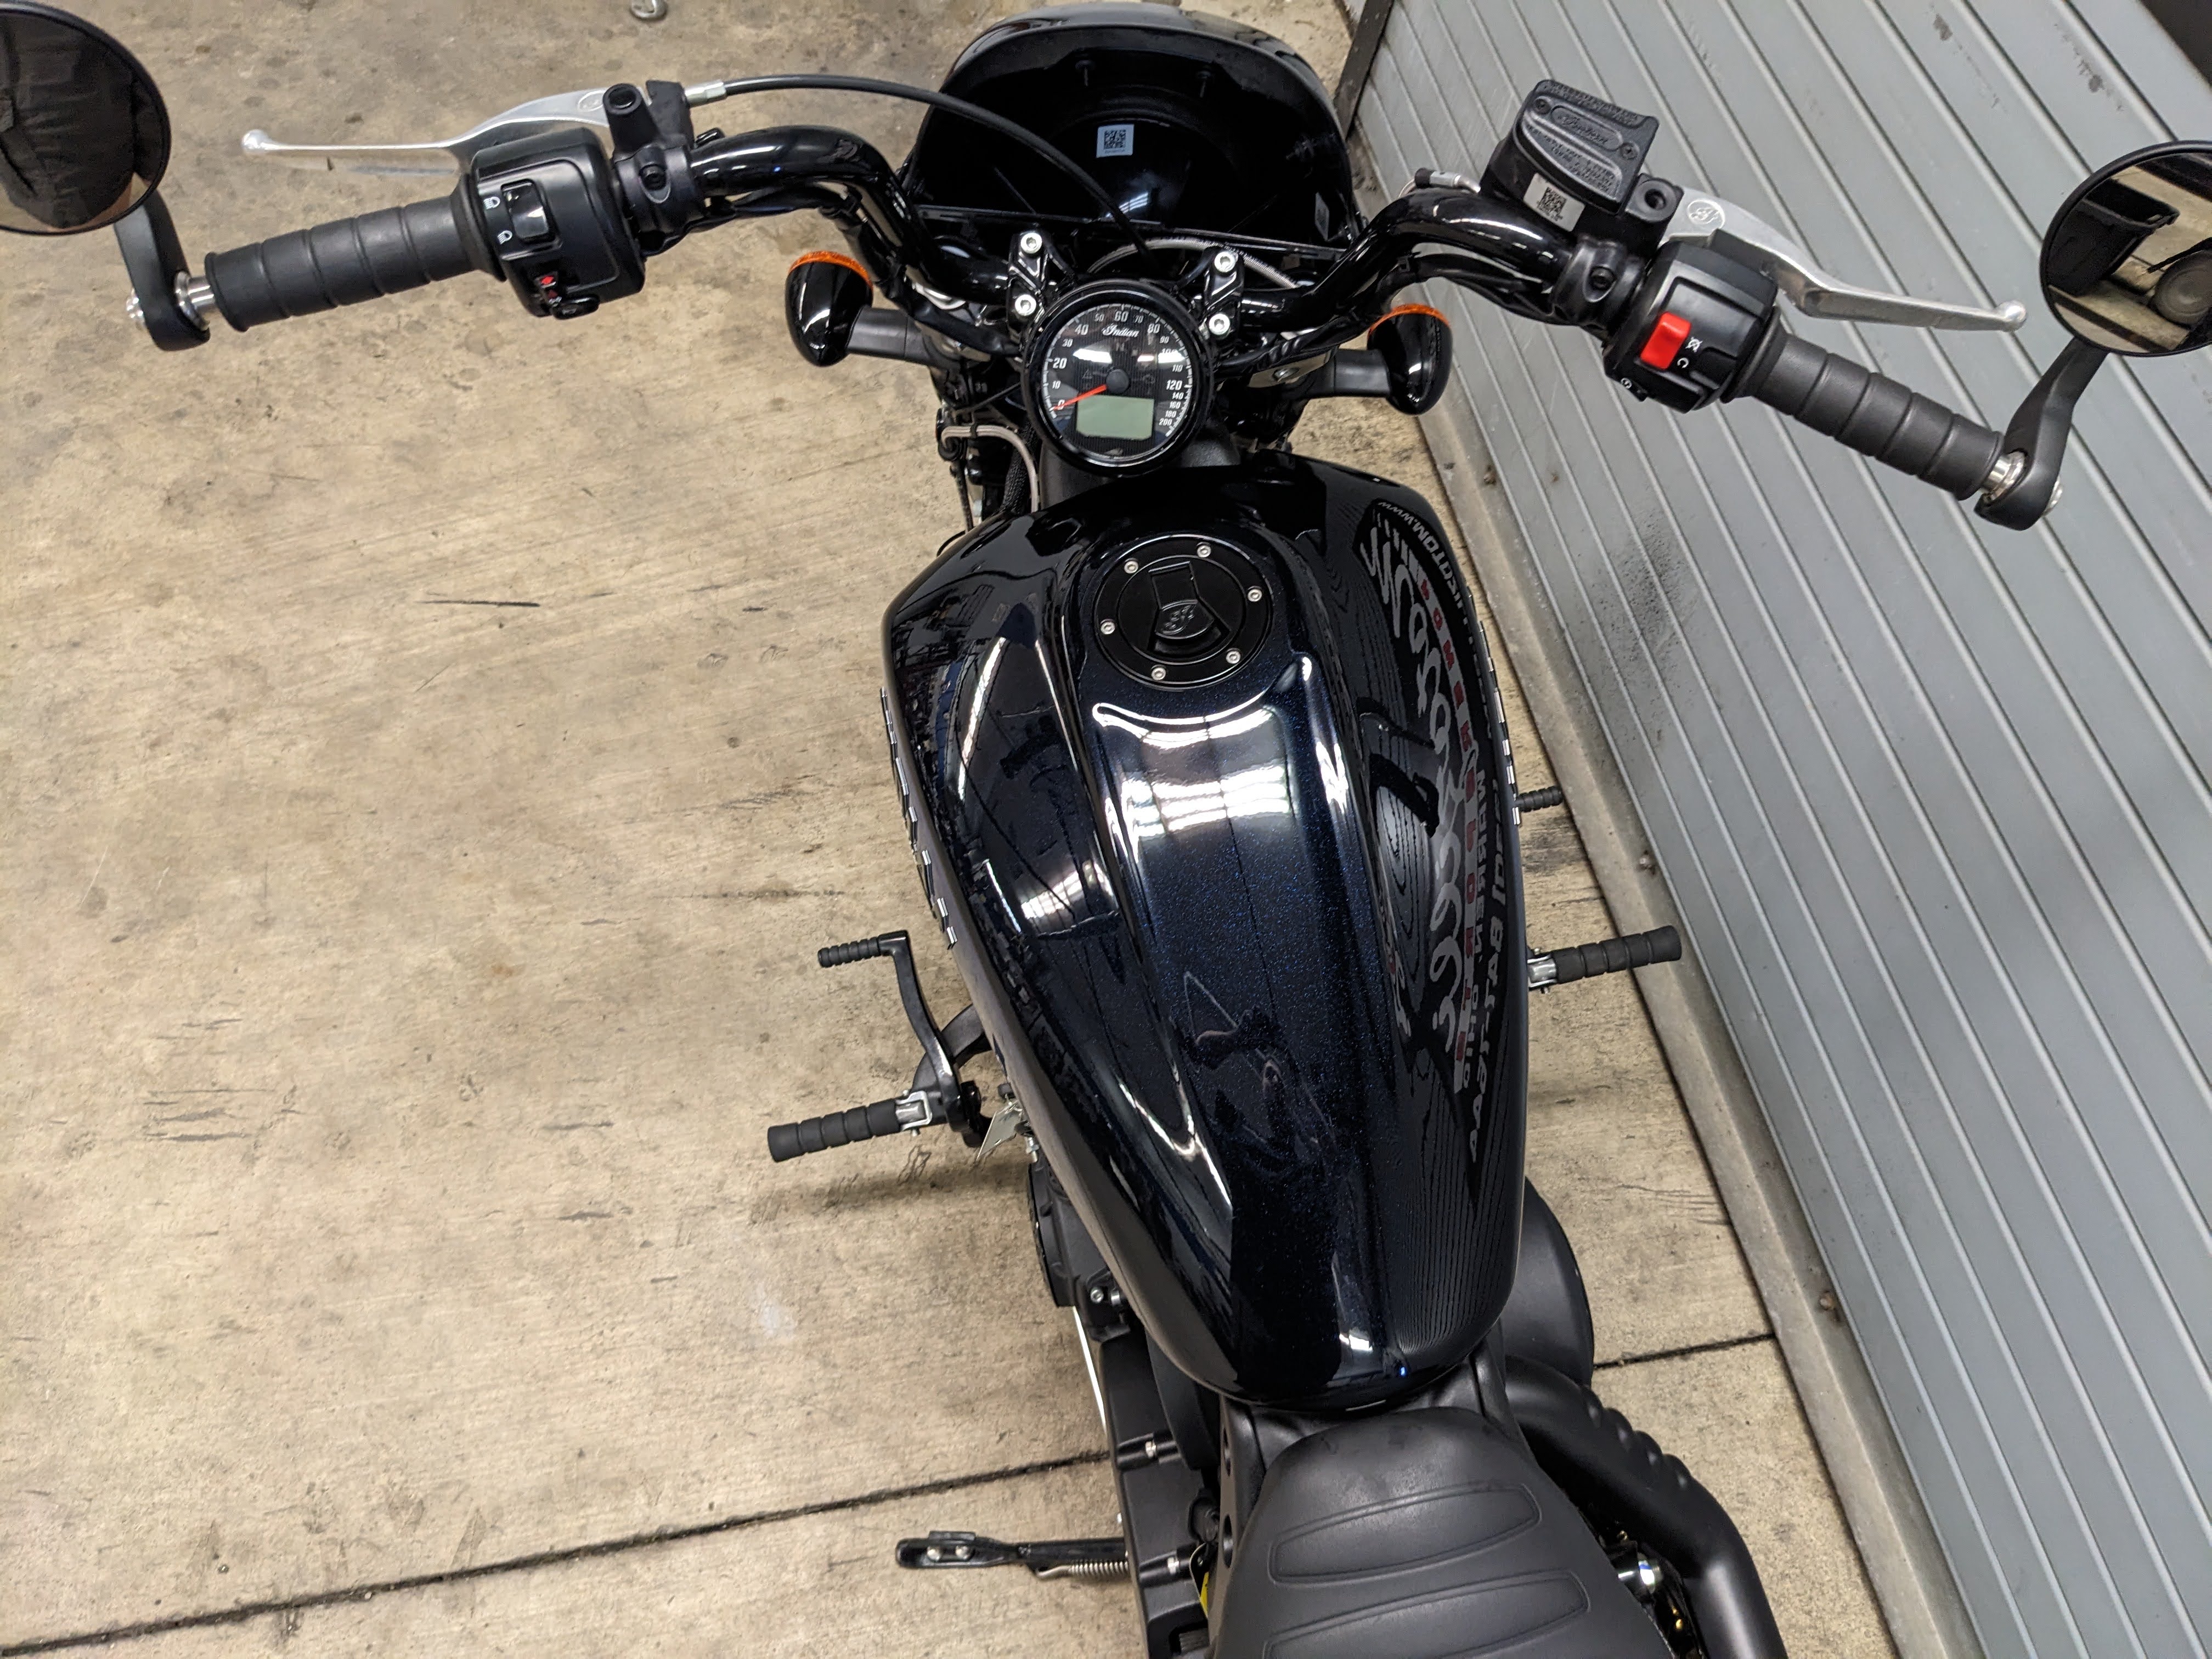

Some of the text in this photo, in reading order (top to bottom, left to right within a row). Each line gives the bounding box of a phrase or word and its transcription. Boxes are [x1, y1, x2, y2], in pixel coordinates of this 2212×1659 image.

[1094, 313, 1105, 322] 50
[1114, 311, 1129, 322] 60
[1133, 314, 1144, 323] 70
[1075, 324, 1089, 336] 40
[1101, 323, 1139, 337] Indian
[1147, 323, 1160, 334] 80
[1062, 338, 1073, 347] 30
[1160, 336, 1170, 344] 90
[1053, 358, 1068, 369] 20
[1172, 364, 1183, 373] 110
[1052, 381, 1061, 389] 10
[1166, 380, 1183, 390] 120
[1165, 410, 1177, 419] 180
[1159, 418, 1172, 426] 200
